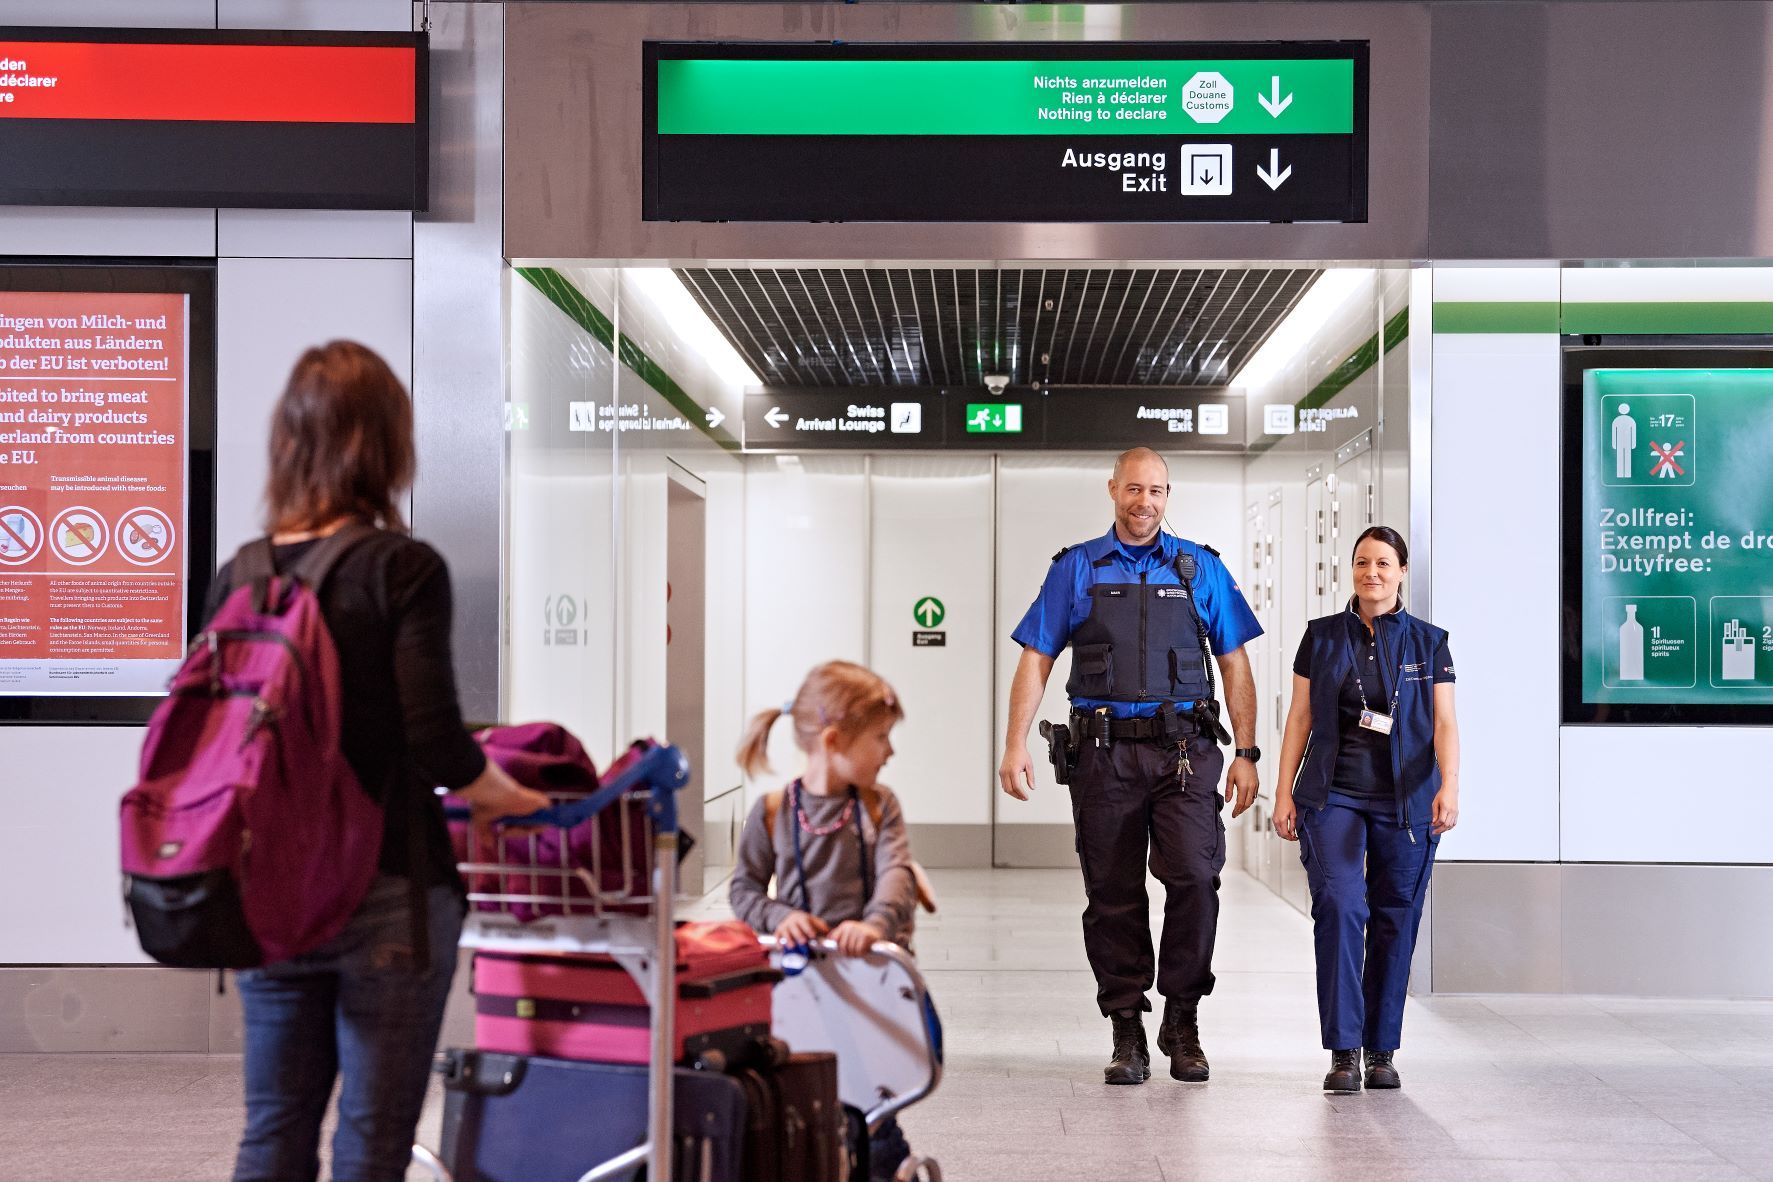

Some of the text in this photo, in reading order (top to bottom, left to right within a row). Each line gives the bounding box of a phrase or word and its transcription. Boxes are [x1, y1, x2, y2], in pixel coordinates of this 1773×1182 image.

[0, 57, 27, 71] den
[0, 73, 58, 87] déclarer
[1034, 76, 1166, 88] Nichts anzumelden
[1200, 80, 1216, 88] Zoll
[0, 92, 15, 103] re
[1062, 92, 1167, 104] Rien à déclarer
[1190, 91, 1226, 99] Douane
[1186, 101, 1230, 109] Customs
[1038, 108, 1166, 122] Nothing to declare
[1061, 148, 1166, 171] Ausgang
[1122, 173, 1167, 192] Exit
[47, 318, 78, 328] von
[80, 315, 132, 328] Milch-
[135, 315, 166, 329] und
[64, 339, 92, 349] aus
[95, 335, 164, 350] Ländern
[10, 355, 37, 369] der
[40, 355, 64, 369] EU
[67, 356, 88, 369] ist
[91, 356, 168, 370] verboten!
[41, 391, 58, 403] to
[61, 388, 105, 406] bring
[108, 391, 148, 403] meat
[28, 408, 71, 426] dairy
[75, 409, 148, 426] products
[847, 405, 885, 418] Swiss
[1136, 406, 1192, 421] Ausgang
[795, 418, 885, 433] Arrival Lounge
[1168, 420, 1193, 432] Exit
[1659, 414, 1674, 427] 17
[55, 429, 94, 444] from
[98, 430, 175, 444] countries
[11, 450, 38, 464] EU.
[1600, 507, 1693, 526] Zollfrei:
[1601, 530, 1692, 552] Exempt
[1701, 530, 1731, 549] de
[1601, 554, 1711, 576] Dutyfree:
